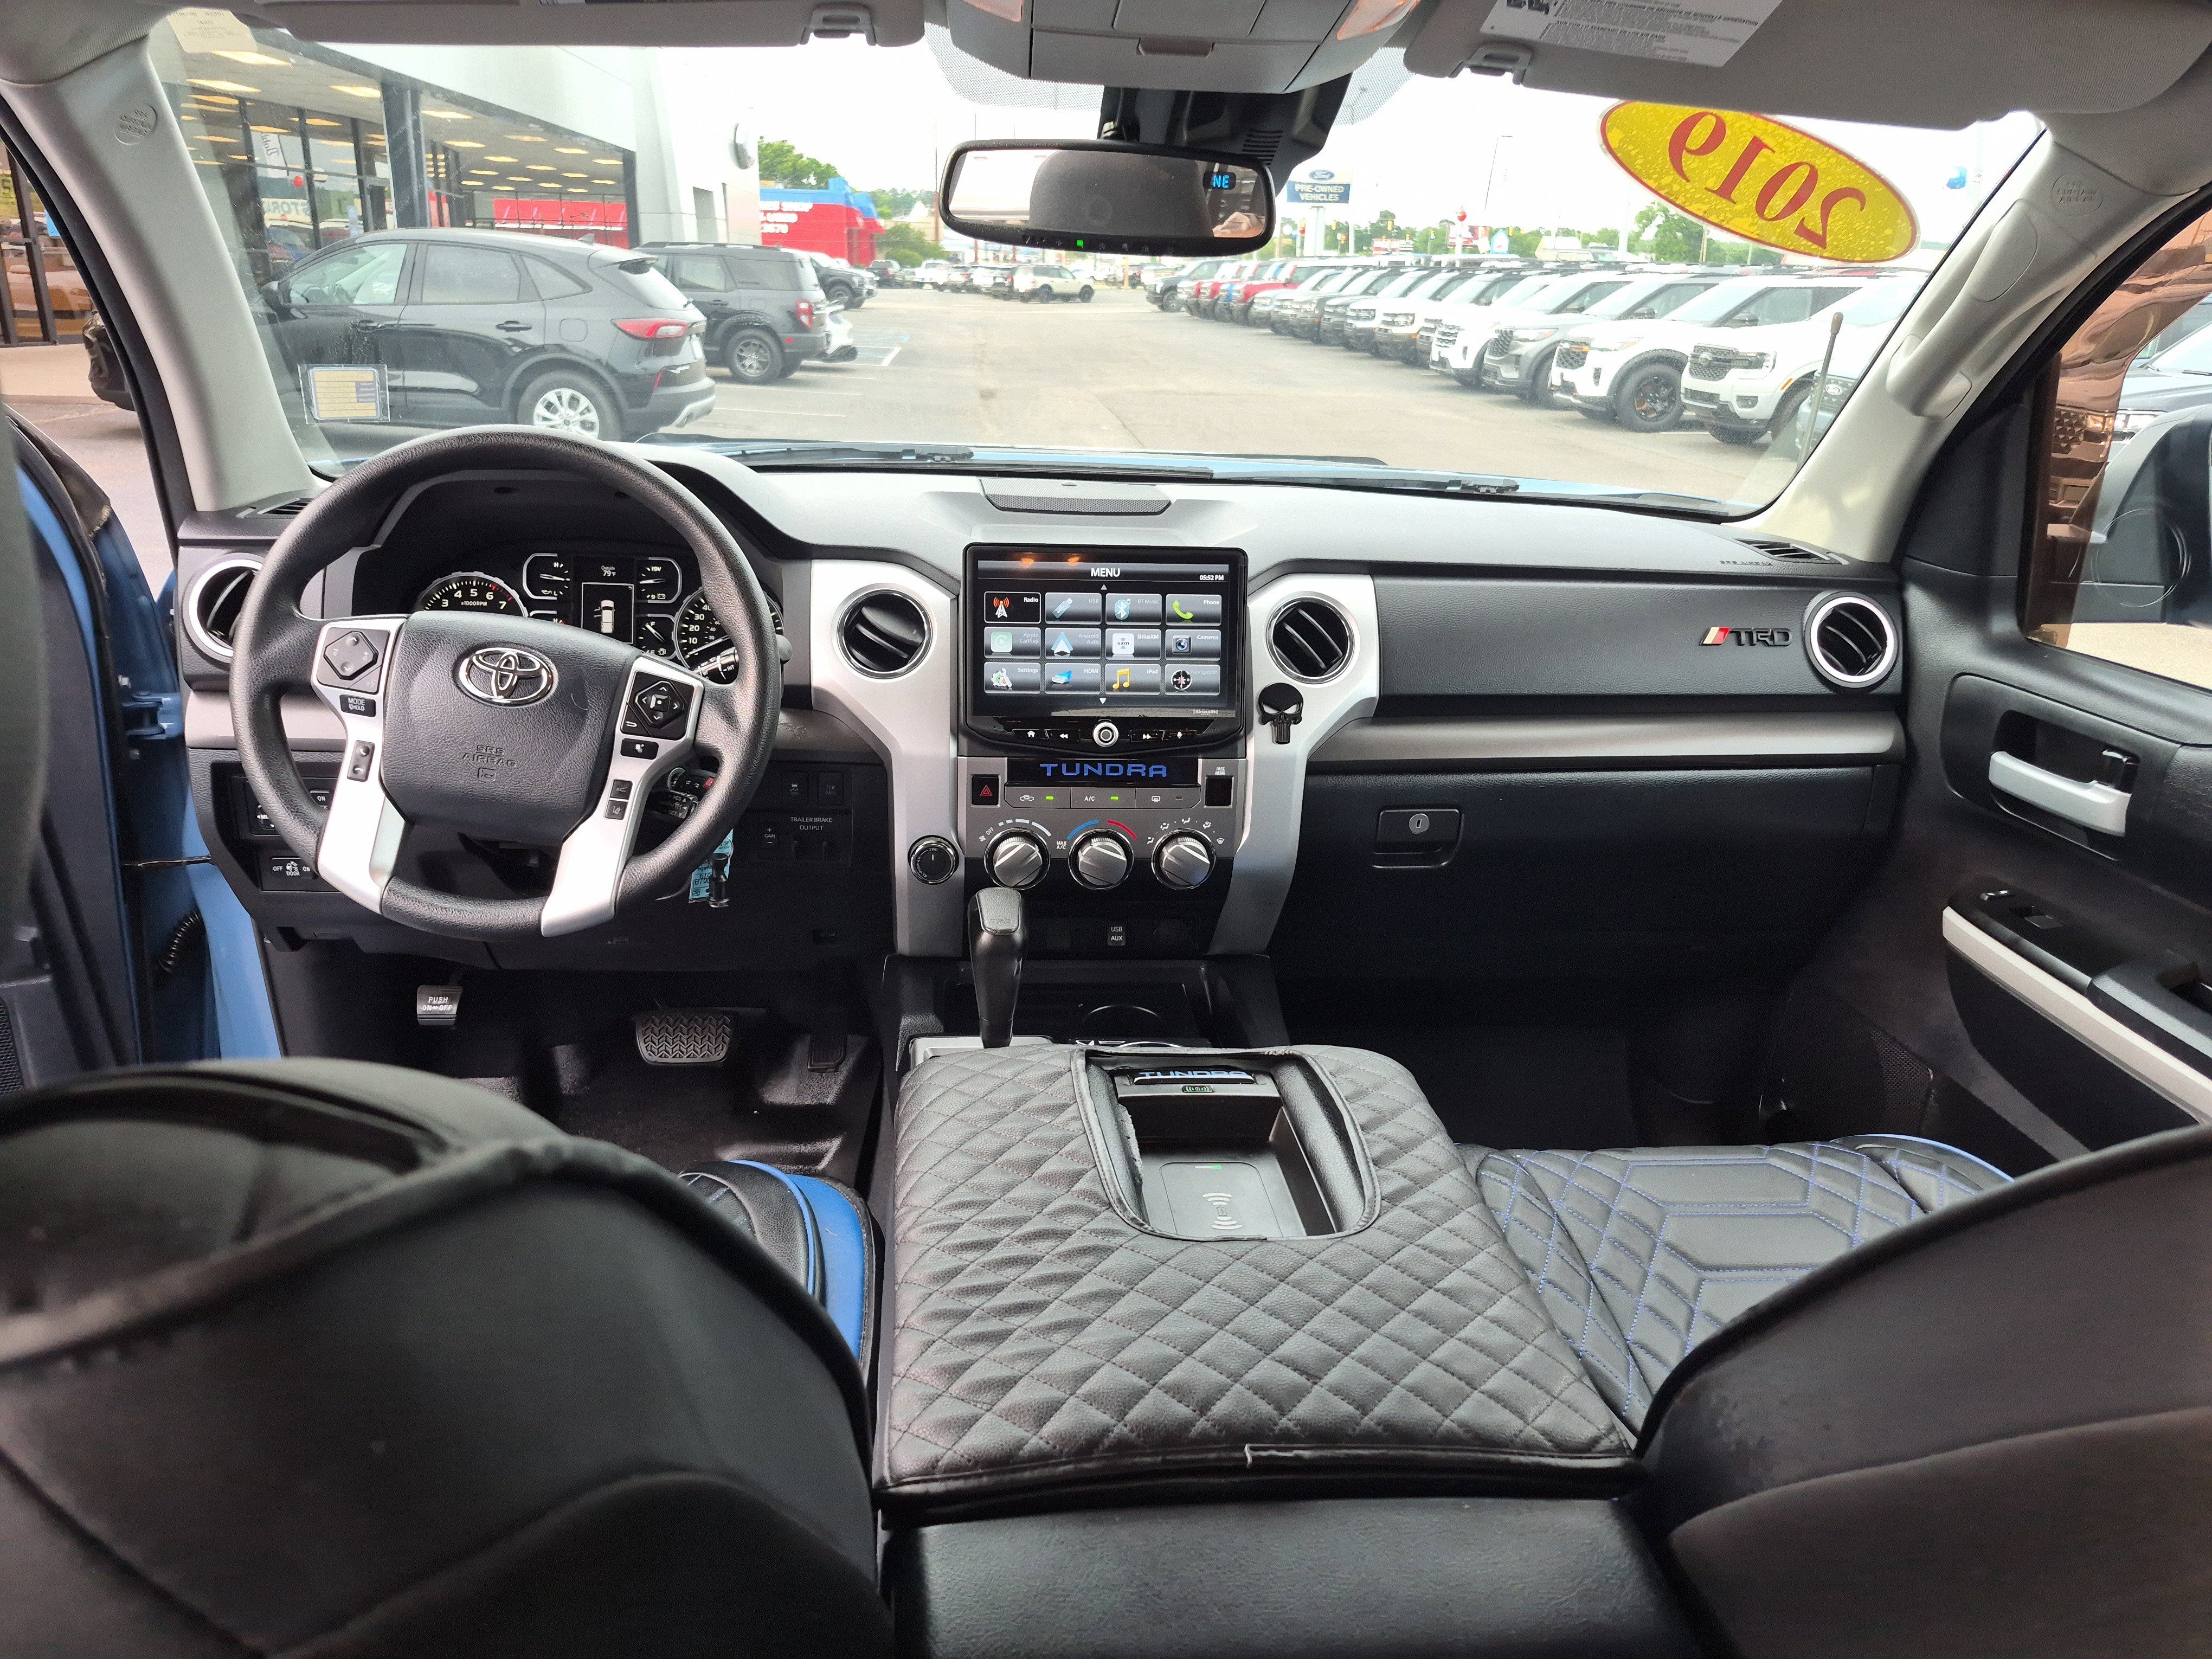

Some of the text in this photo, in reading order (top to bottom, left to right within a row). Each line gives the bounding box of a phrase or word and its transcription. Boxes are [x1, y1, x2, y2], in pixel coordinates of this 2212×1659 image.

[1213, 175, 1230, 188] NE
[1294, 184, 1344, 192] PRE-OWNED
[781, 202, 813, 212] SHOP
[1091, 568, 1121, 577] MENU
[1729, 627, 1792, 647] TRD
[348, 697, 365, 705] MODE
[462, 753, 517, 767] AIRBAG
[1040, 763, 1167, 777] TUNDRA
[986, 827, 994, 835] OFF
